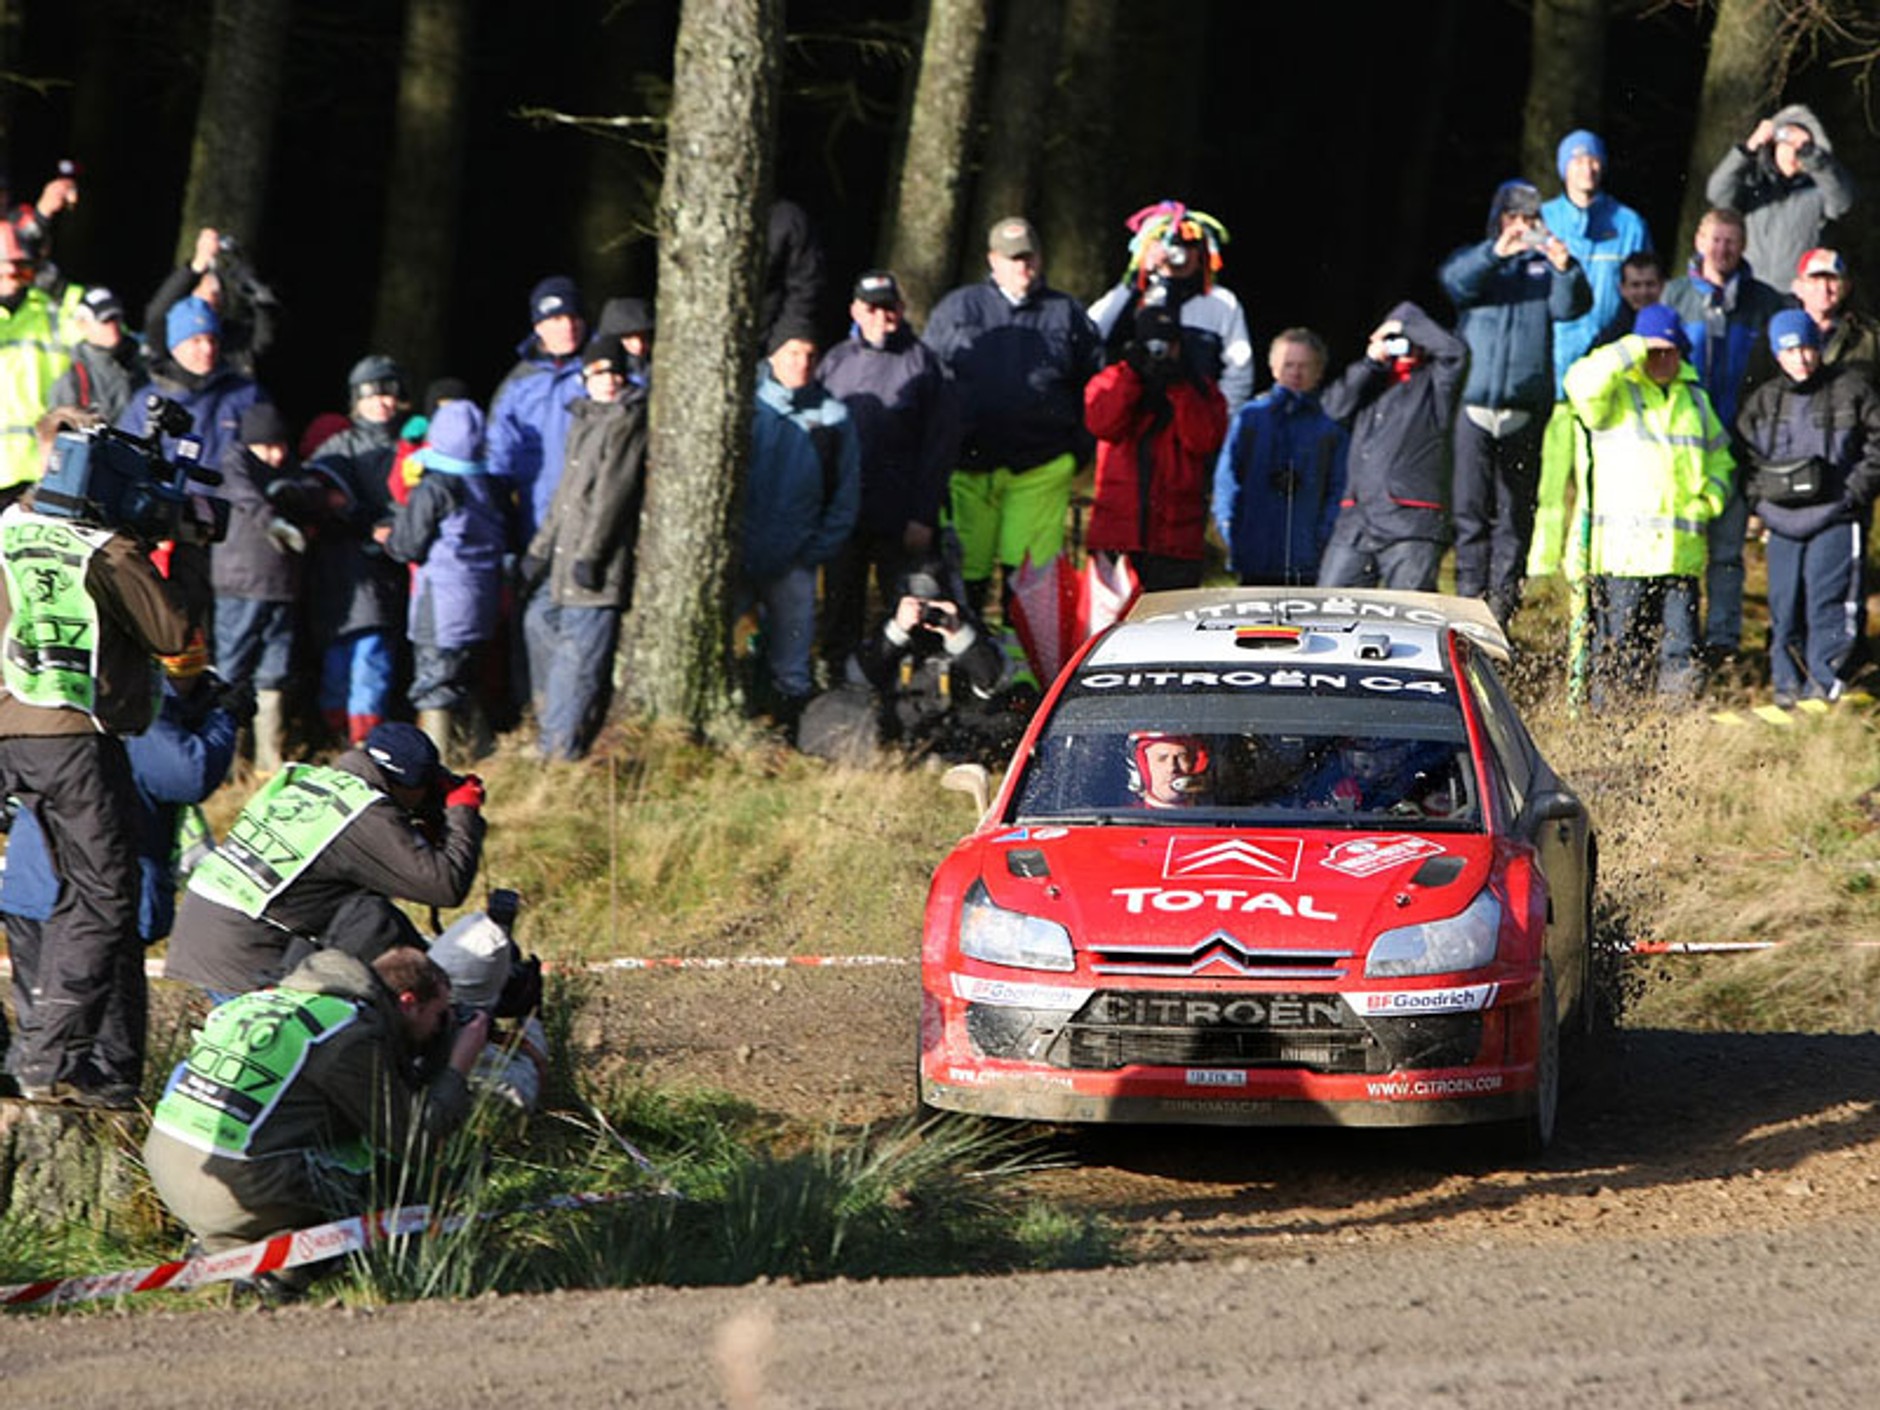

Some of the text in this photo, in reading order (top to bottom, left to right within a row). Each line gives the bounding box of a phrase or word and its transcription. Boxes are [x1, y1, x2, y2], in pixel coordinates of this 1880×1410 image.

[1081, 669, 1446, 694] CITROËN C4
[1112, 887, 1337, 920] TOTAL
[1091, 995, 1344, 1024] CITROËN
[1367, 991, 1475, 1008] BFGoodrich
